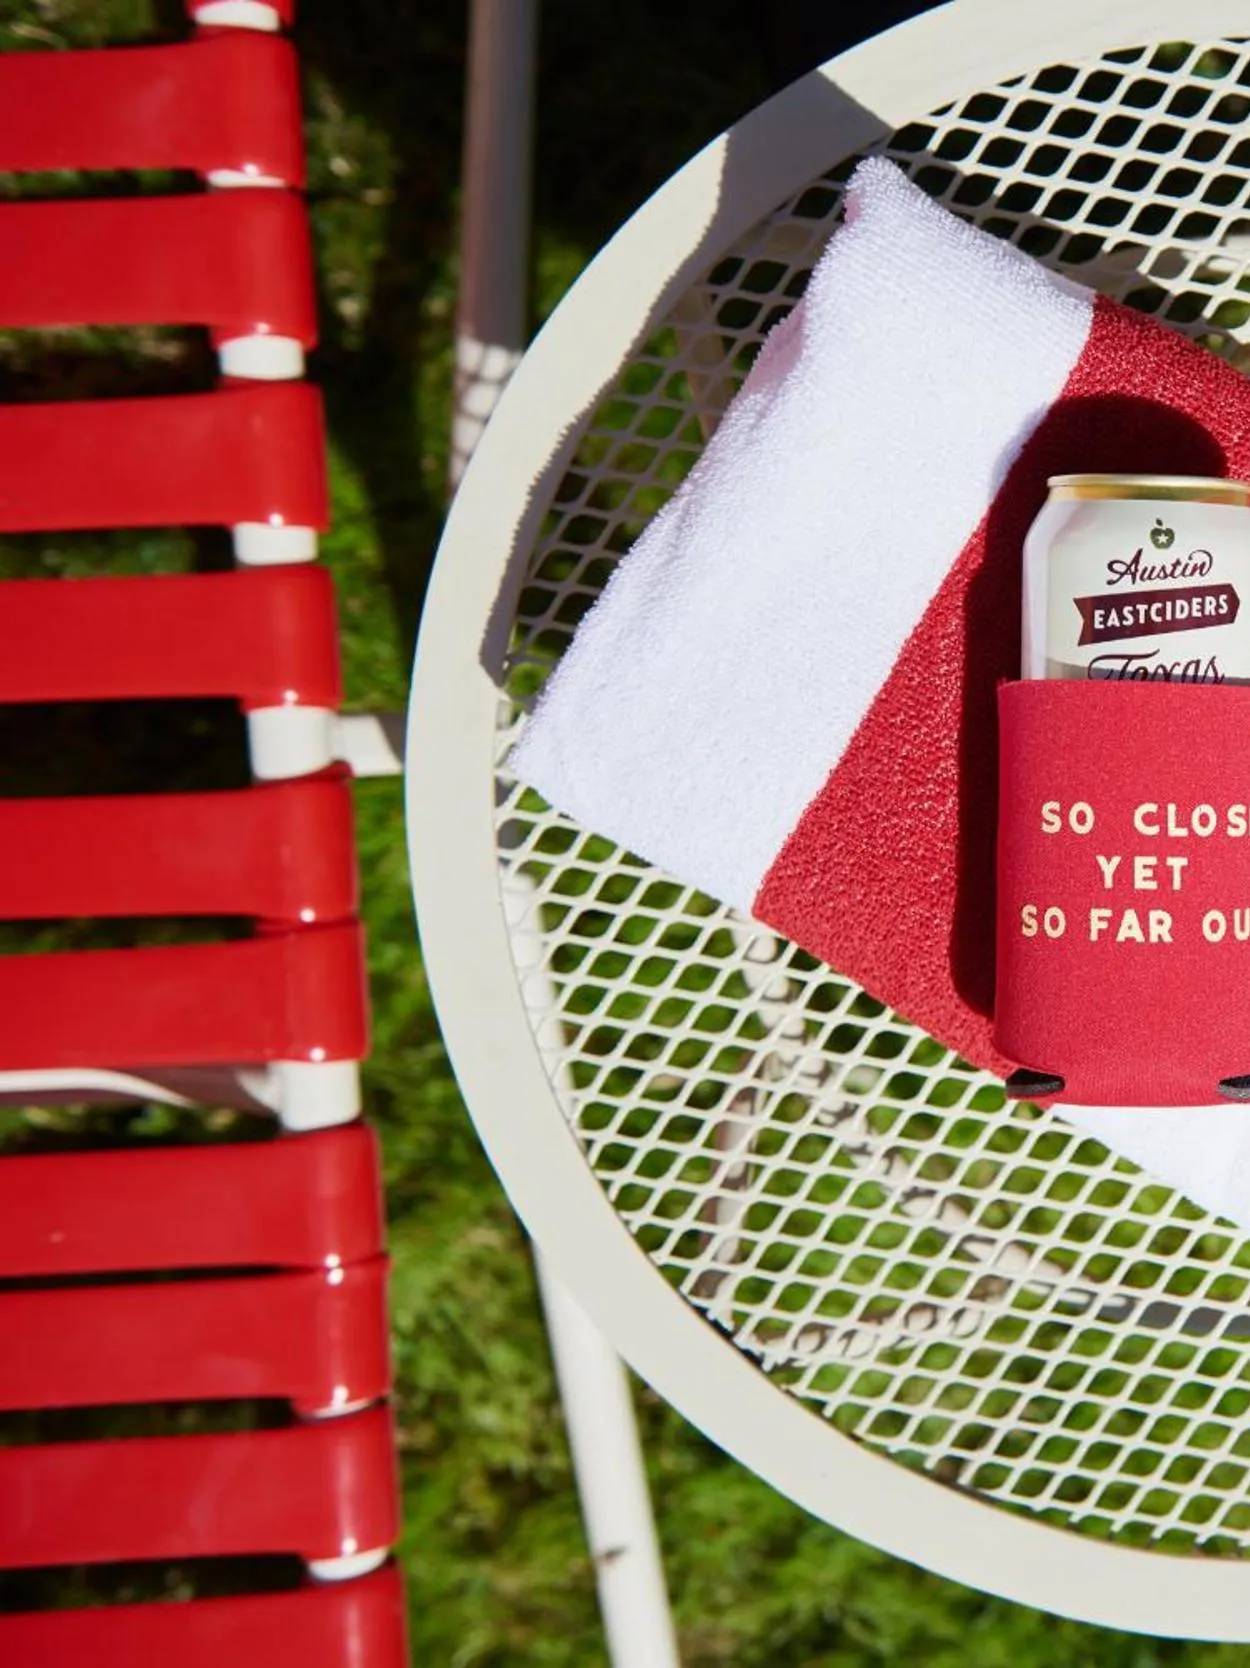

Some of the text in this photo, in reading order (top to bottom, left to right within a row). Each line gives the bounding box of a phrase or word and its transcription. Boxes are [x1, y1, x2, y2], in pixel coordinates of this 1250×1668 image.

[1106, 548, 1214, 586] Austin
[1093, 594, 1229, 630] EASTCIDERS
[1041, 801, 1095, 835] SO
[1096, 855, 1189, 891] YET
[1021, 904, 1066, 938] SO
[1089, 908, 1173, 943] FAR
